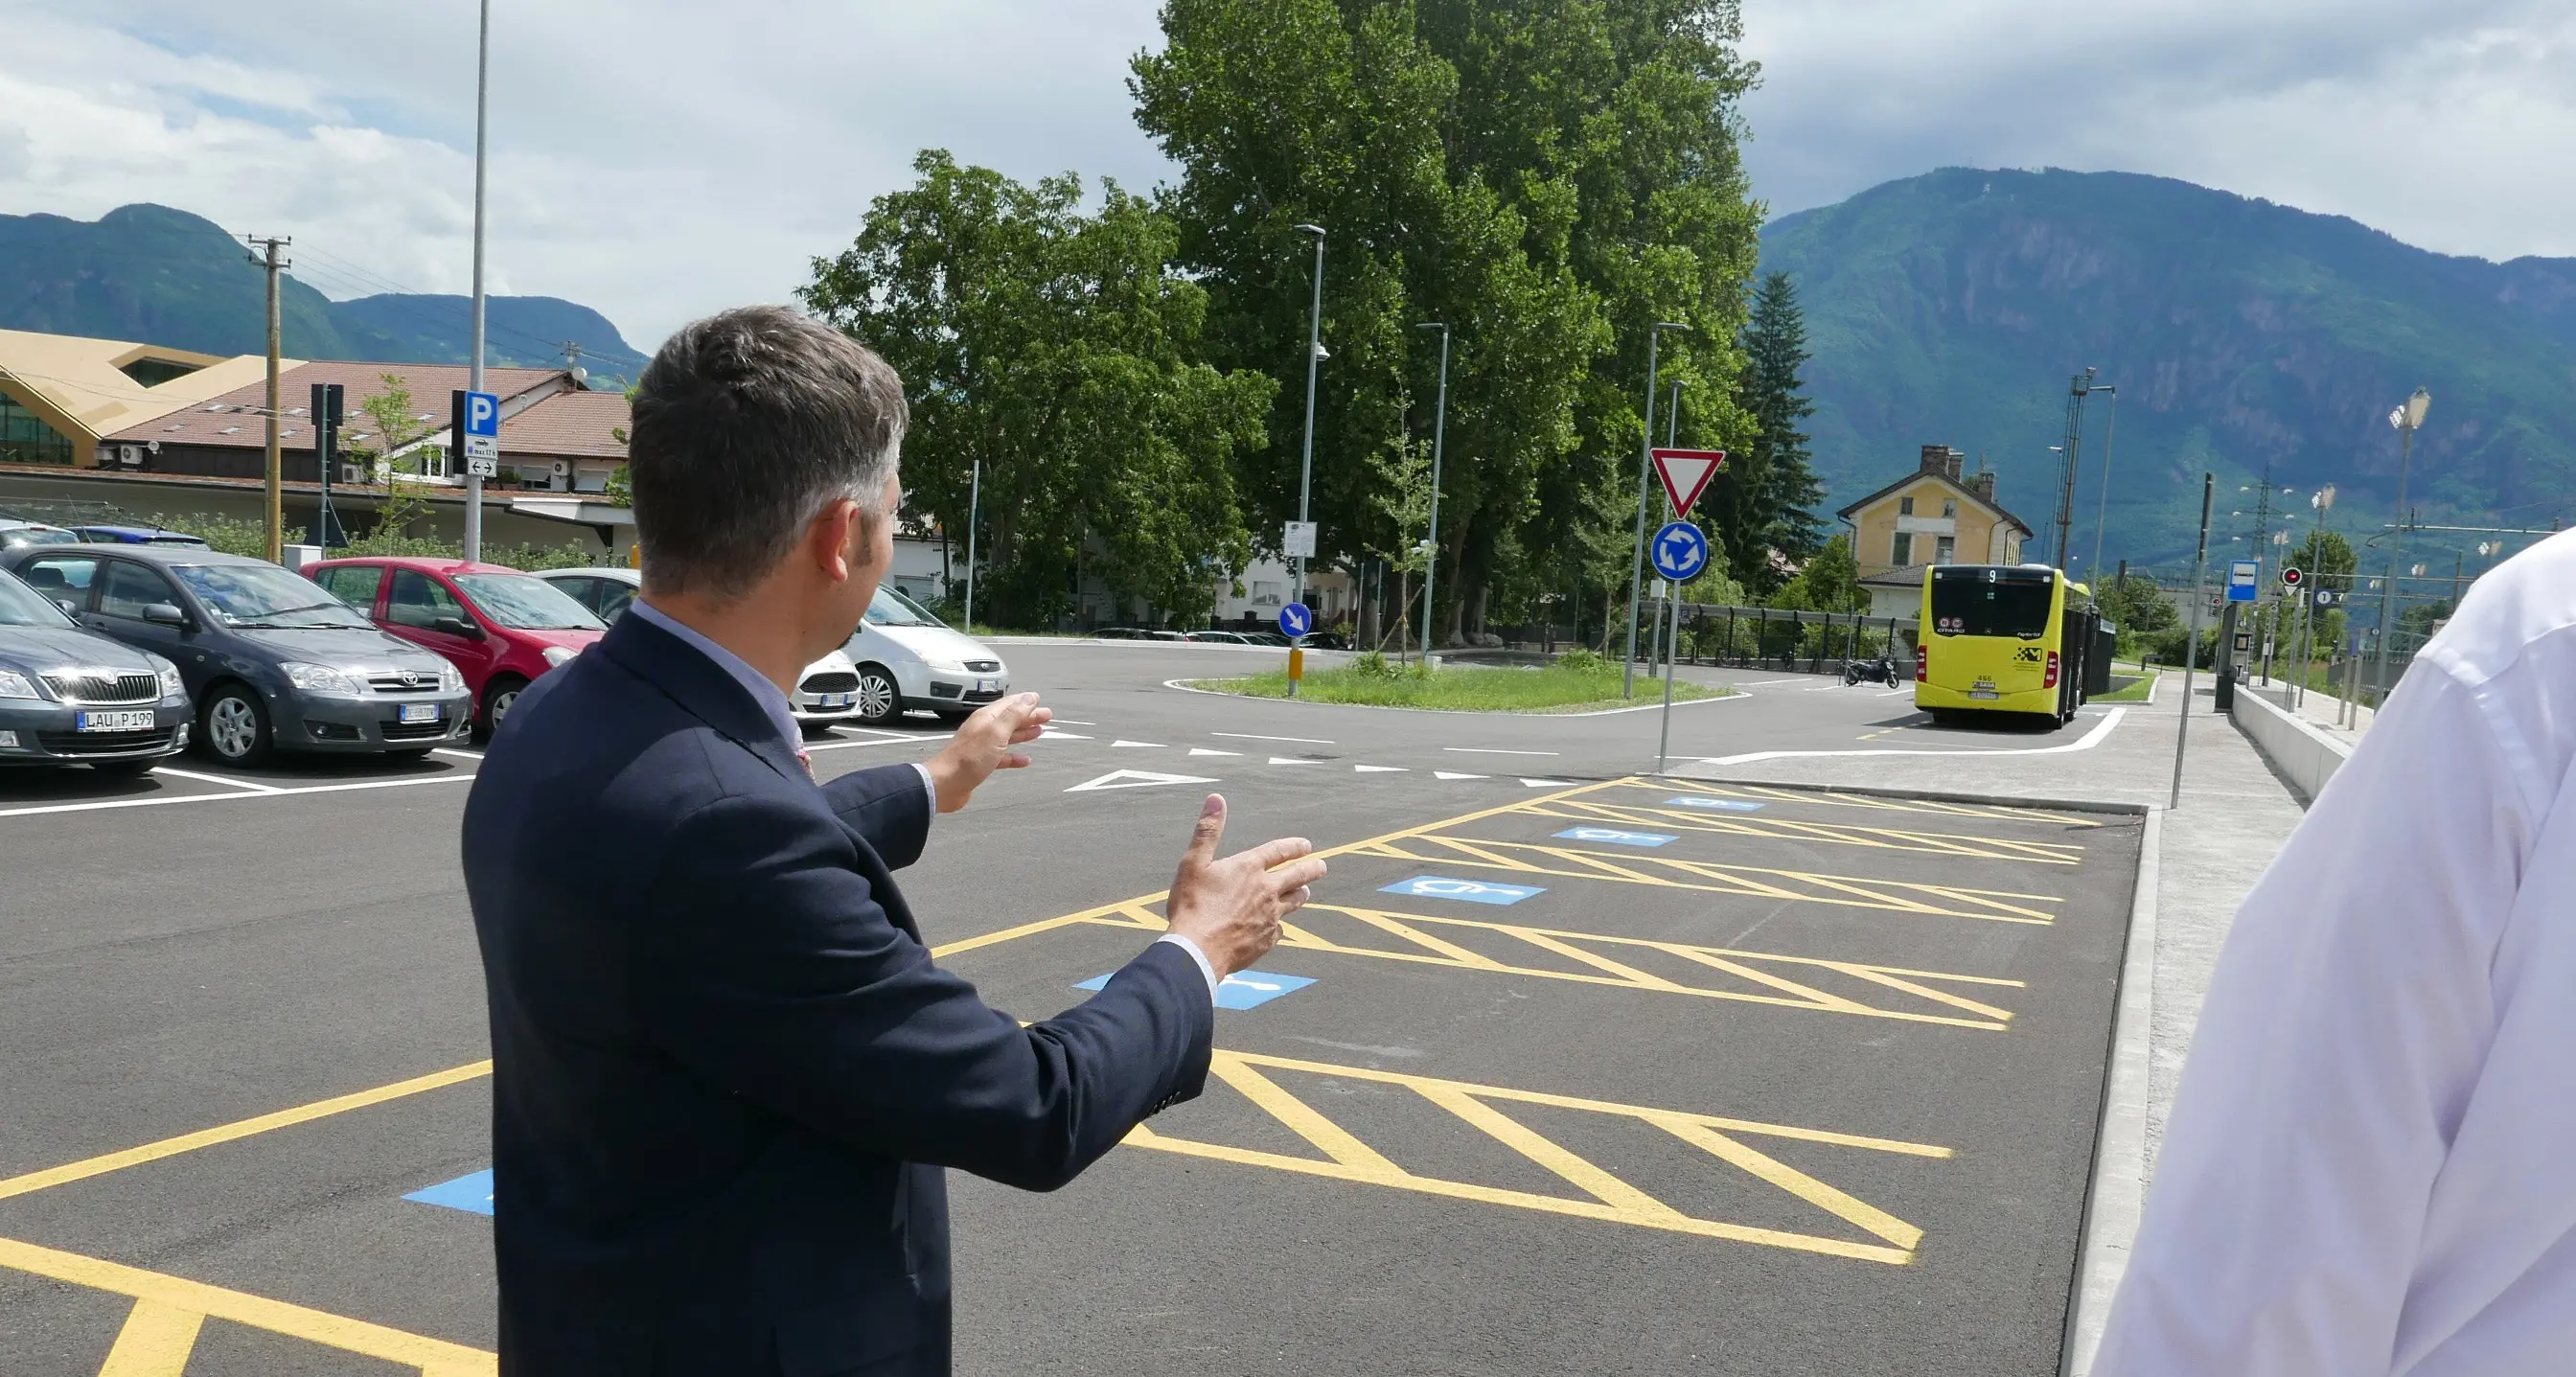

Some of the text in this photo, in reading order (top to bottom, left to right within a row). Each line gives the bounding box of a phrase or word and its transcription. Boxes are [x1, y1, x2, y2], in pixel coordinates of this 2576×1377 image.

[472, 397, 492, 431] P
[1990, 569, 1996, 583] 9
[86, 712, 153, 727] LAU P 199
